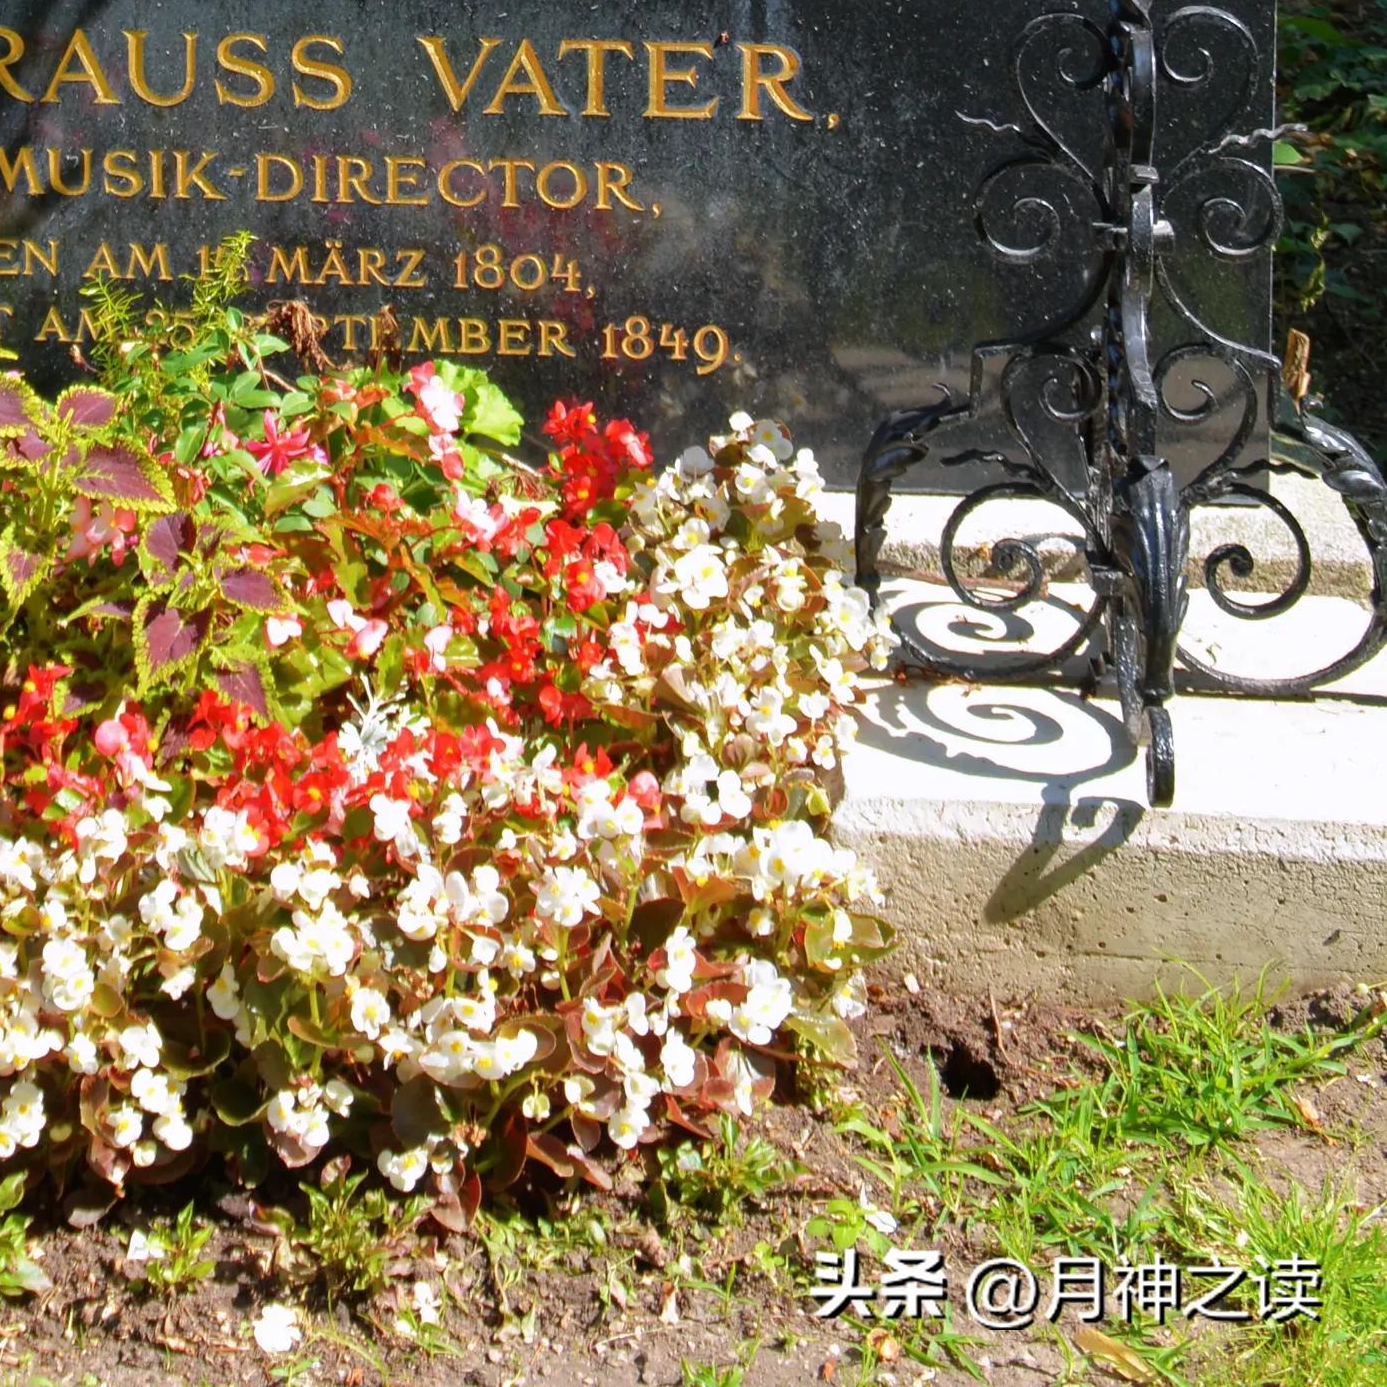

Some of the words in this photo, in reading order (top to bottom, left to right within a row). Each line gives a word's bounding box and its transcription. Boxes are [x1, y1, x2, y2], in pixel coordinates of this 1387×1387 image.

[417, 35, 840, 129] VATER,
[82, 241, 174, 281] AM
[264, 238, 427, 287] MÄRZ
[453, 242, 597, 300] 1804,
[600, 314, 743, 376] 1849.
